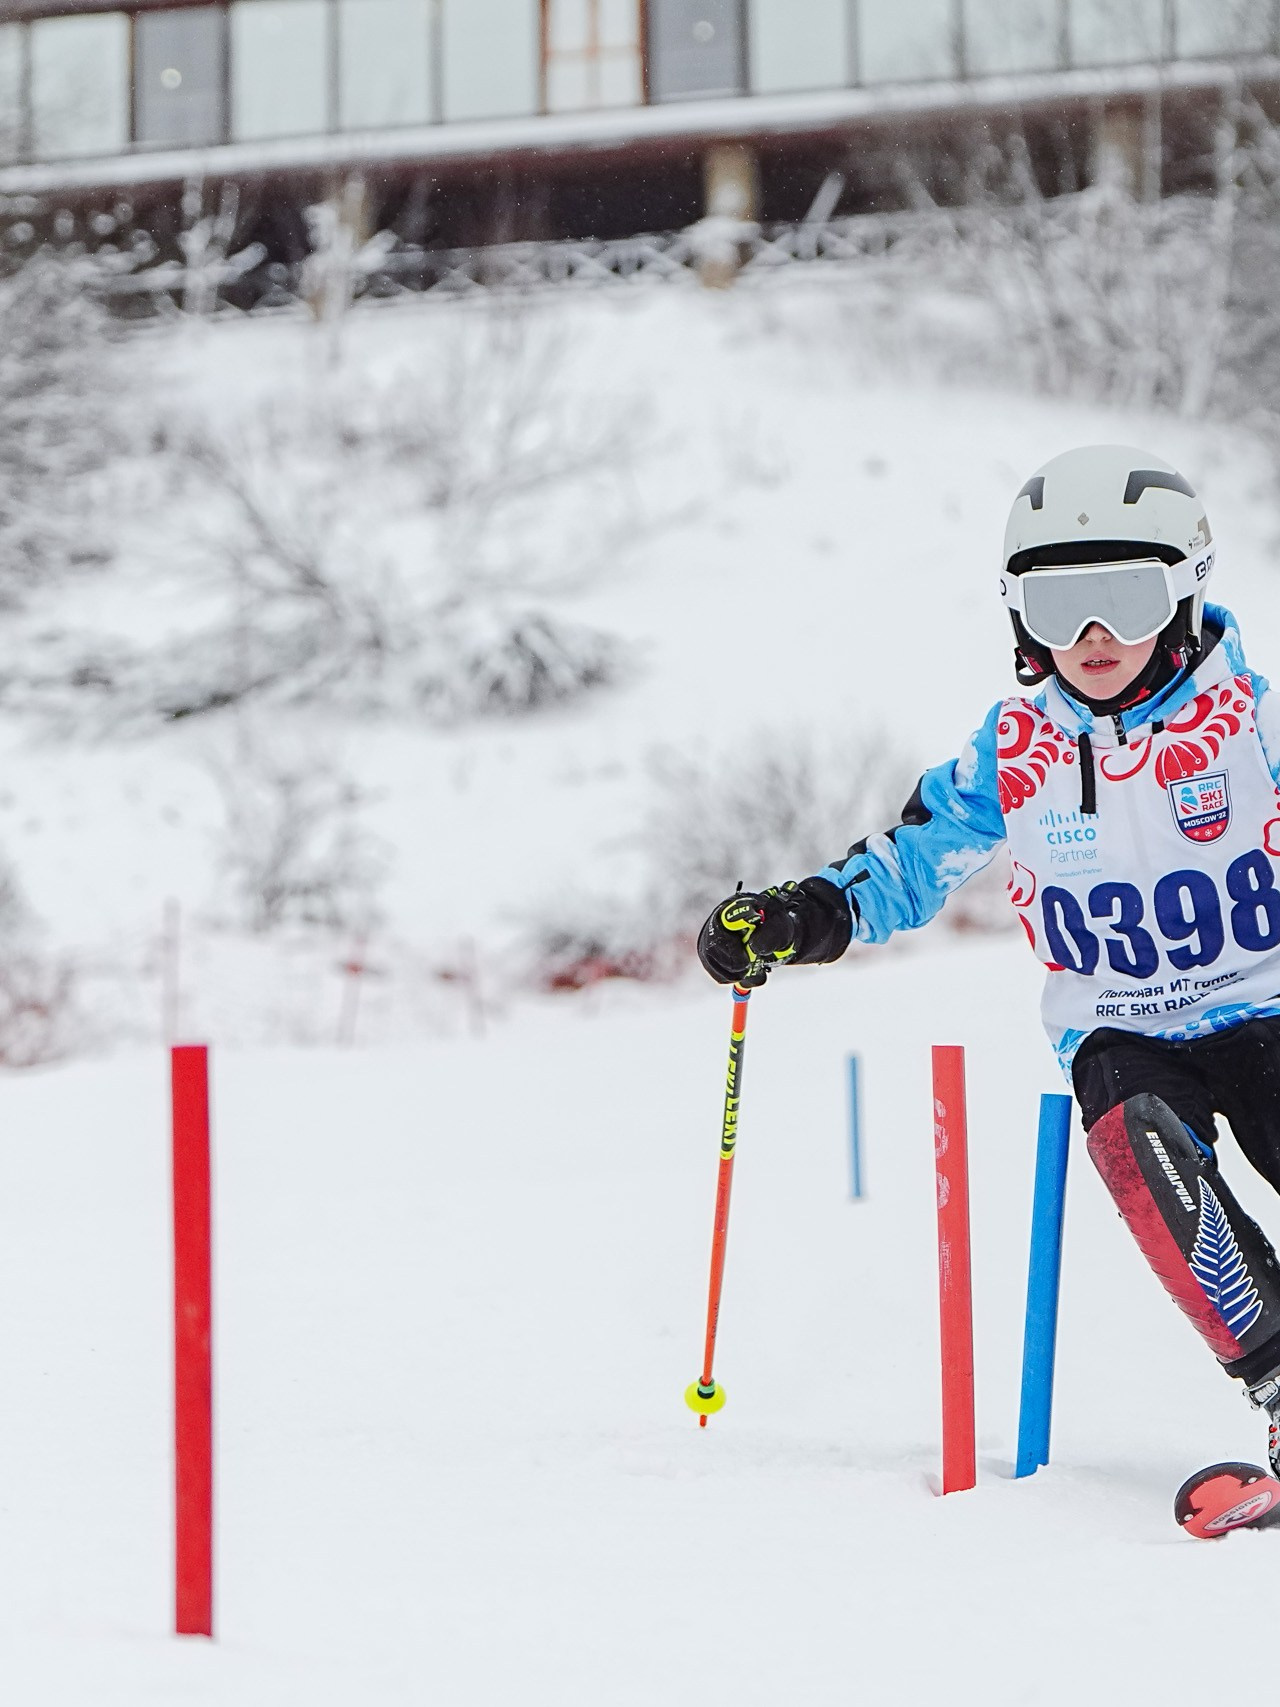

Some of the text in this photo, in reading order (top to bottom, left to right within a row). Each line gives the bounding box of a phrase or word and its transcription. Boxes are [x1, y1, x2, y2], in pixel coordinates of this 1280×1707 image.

[1198, 780, 1222, 792] RRC
[1200, 789, 1224, 804] SKI
[1202, 799, 1225, 811] RACE
[1047, 828, 1096, 845] CISCO
[1050, 848, 1098, 863] Partner
[726, 905, 750, 920] LEKI
[1098, 986, 1164, 999] Лыжная
[1170, 979, 1191, 993] ИТ
[1096, 1004, 1125, 1017] RRC
[1130, 1003, 1160, 1015] SKI
[723, 1097, 740, 1145] LEKI
[1145, 1131, 1197, 1212] ENERGIAPURA
[1212, 1496, 1264, 1525] ROSSIGNOL
